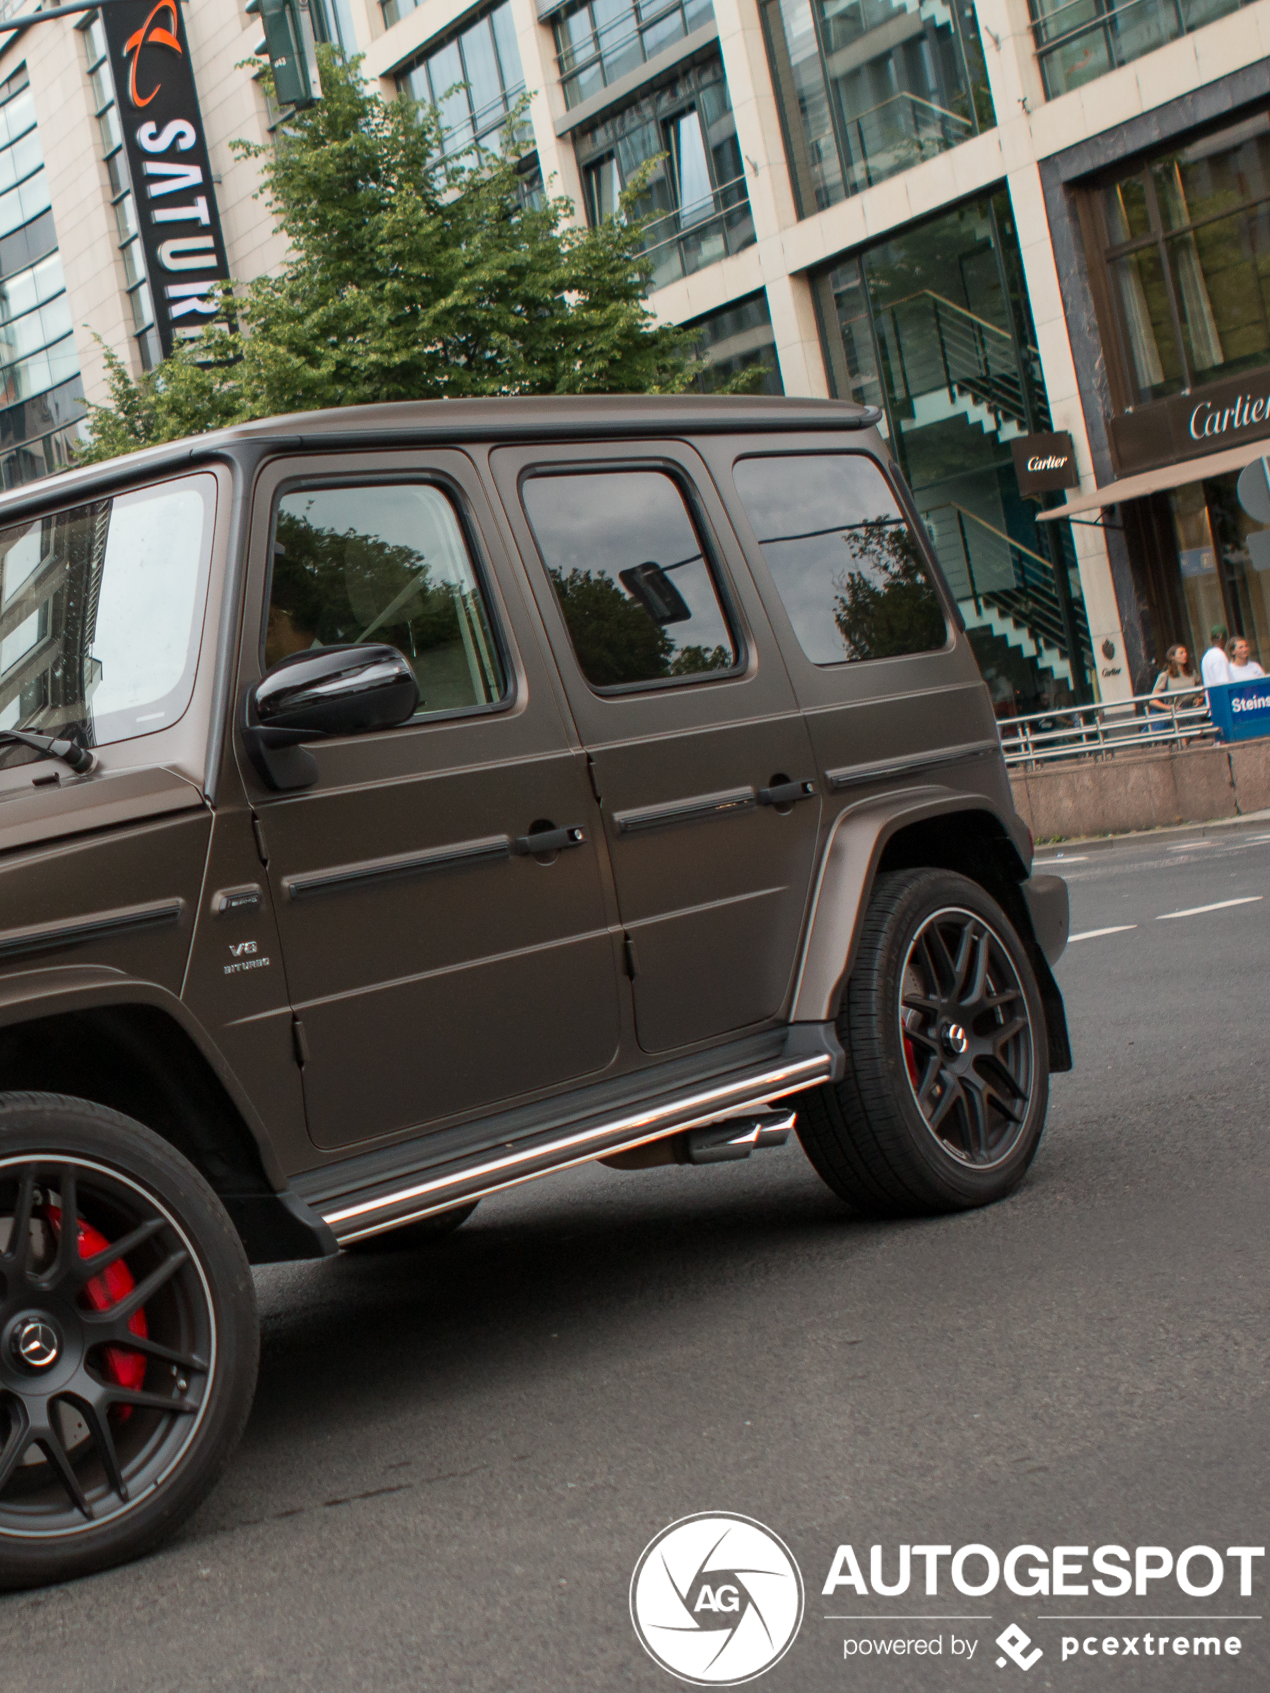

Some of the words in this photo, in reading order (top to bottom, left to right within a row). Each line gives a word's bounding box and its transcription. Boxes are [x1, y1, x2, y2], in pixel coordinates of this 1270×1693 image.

[1027, 455, 1068, 472] Cartier
[1101, 667, 1122, 678] Cartier
[224, 957, 270, 975] BITURBO
